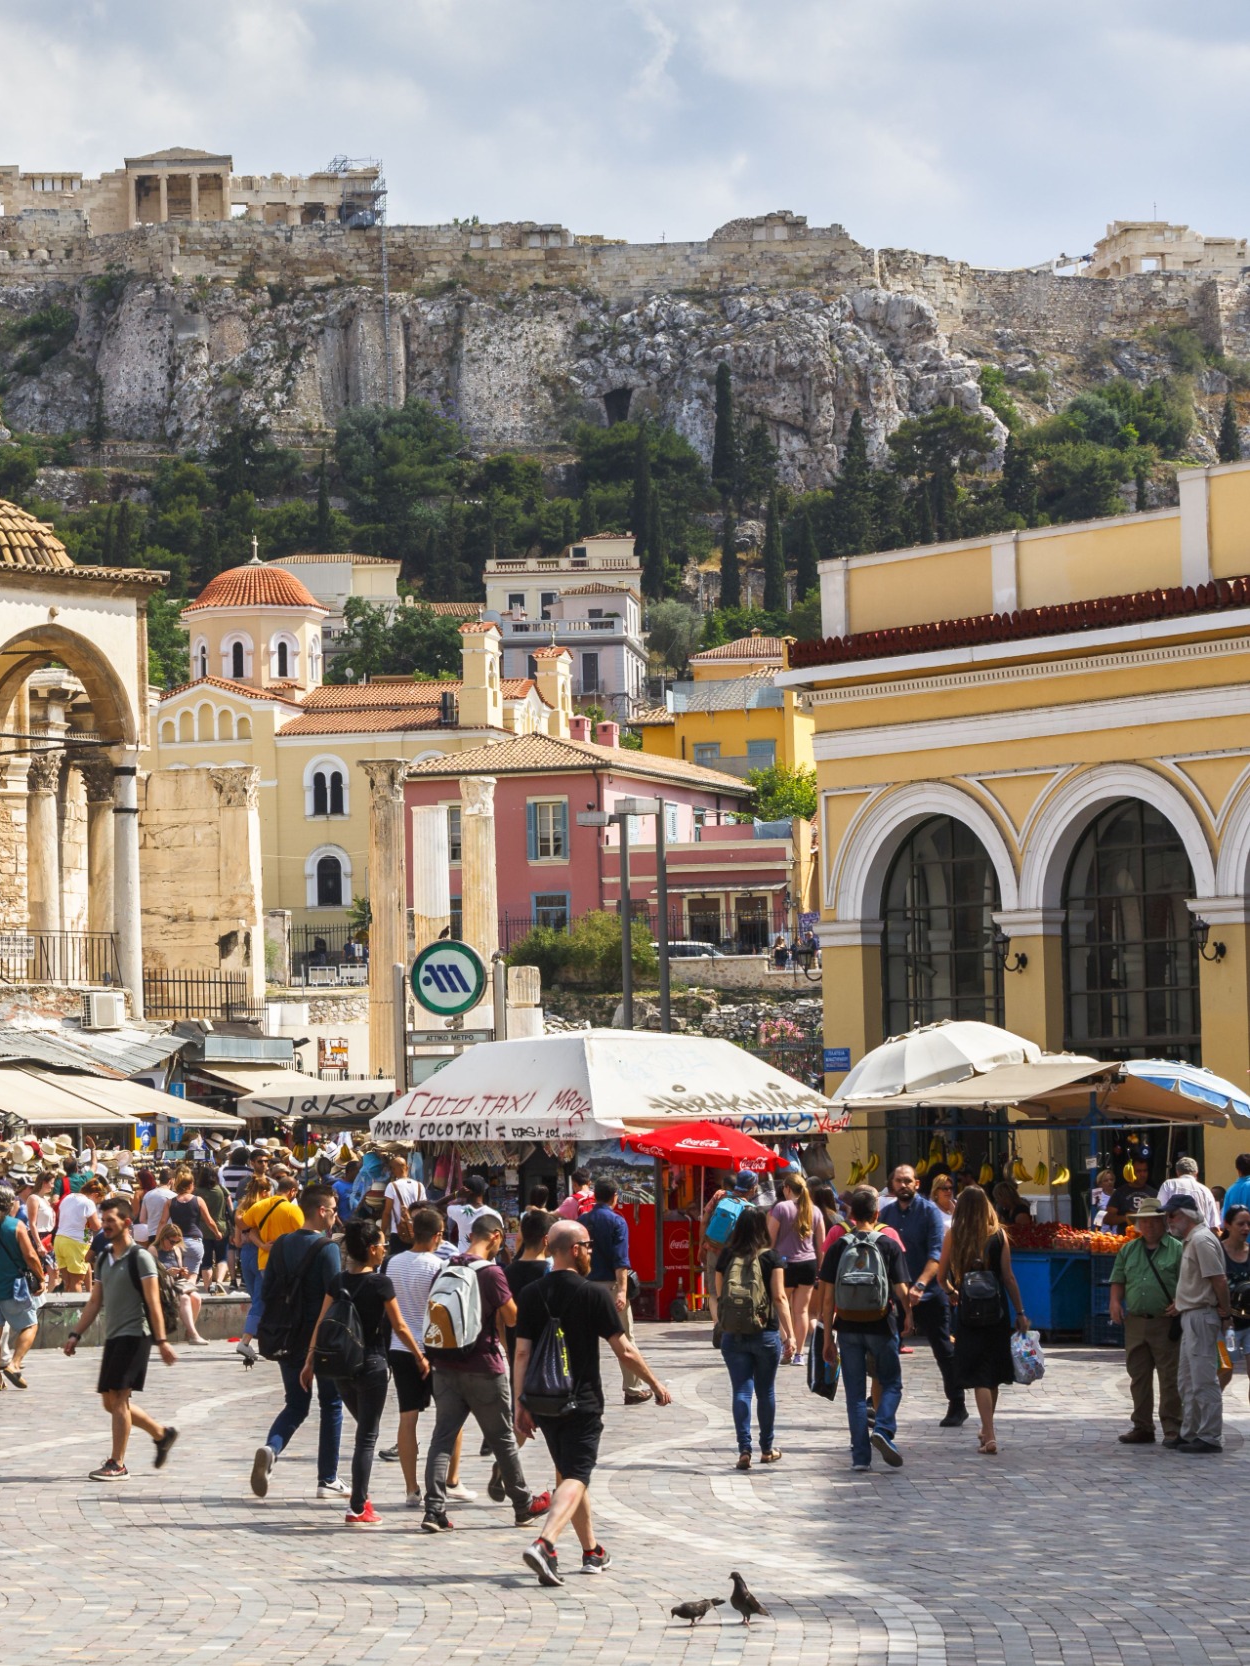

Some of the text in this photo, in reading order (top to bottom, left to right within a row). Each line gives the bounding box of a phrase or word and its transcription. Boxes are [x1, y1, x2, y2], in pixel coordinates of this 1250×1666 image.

[681, 1137, 721, 1148] Coca-Cola
[636, 1142, 666, 1157] Coca-Cola
[739, 1156, 769, 1170] Coca-Cola
[670, 1239, 690, 1250] Coca-Cola
